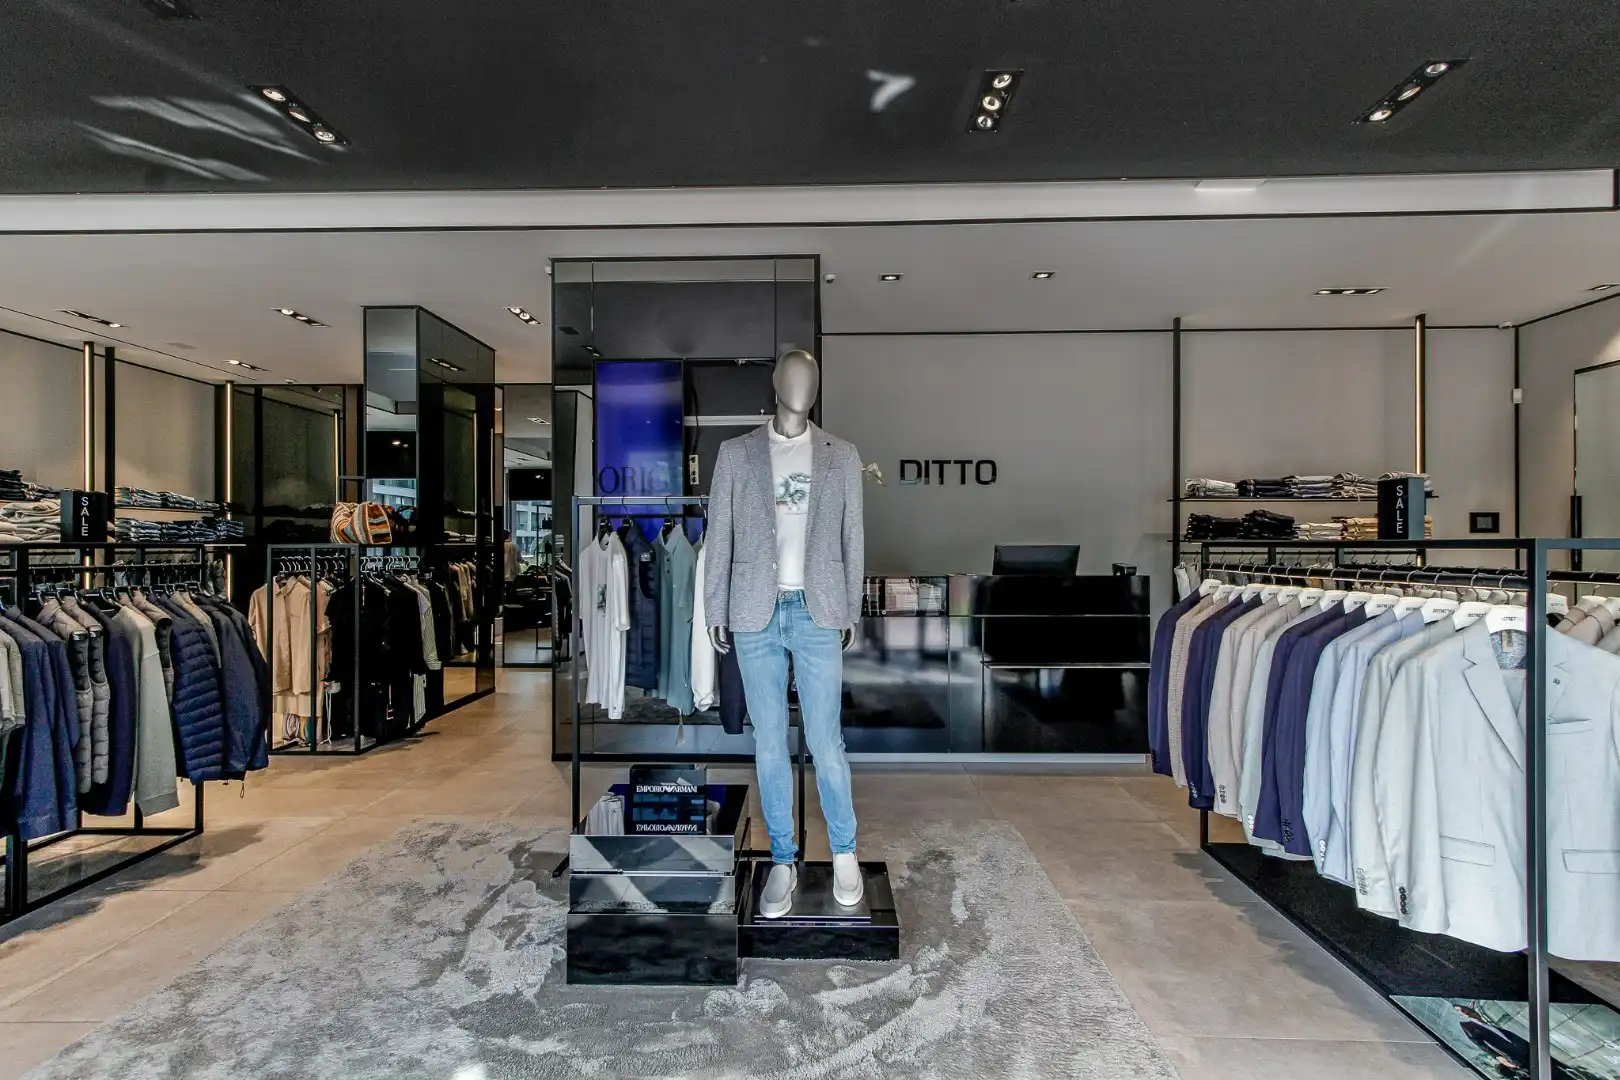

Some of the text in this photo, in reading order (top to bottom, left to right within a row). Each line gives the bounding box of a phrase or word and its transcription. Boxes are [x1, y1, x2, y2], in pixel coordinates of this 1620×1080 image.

[900, 459, 997, 485] DITTO
[81, 496, 90, 537] SALE
[1396, 485, 1404, 534] SALE
[636, 785, 698, 793] EMPORIO ARMANI
